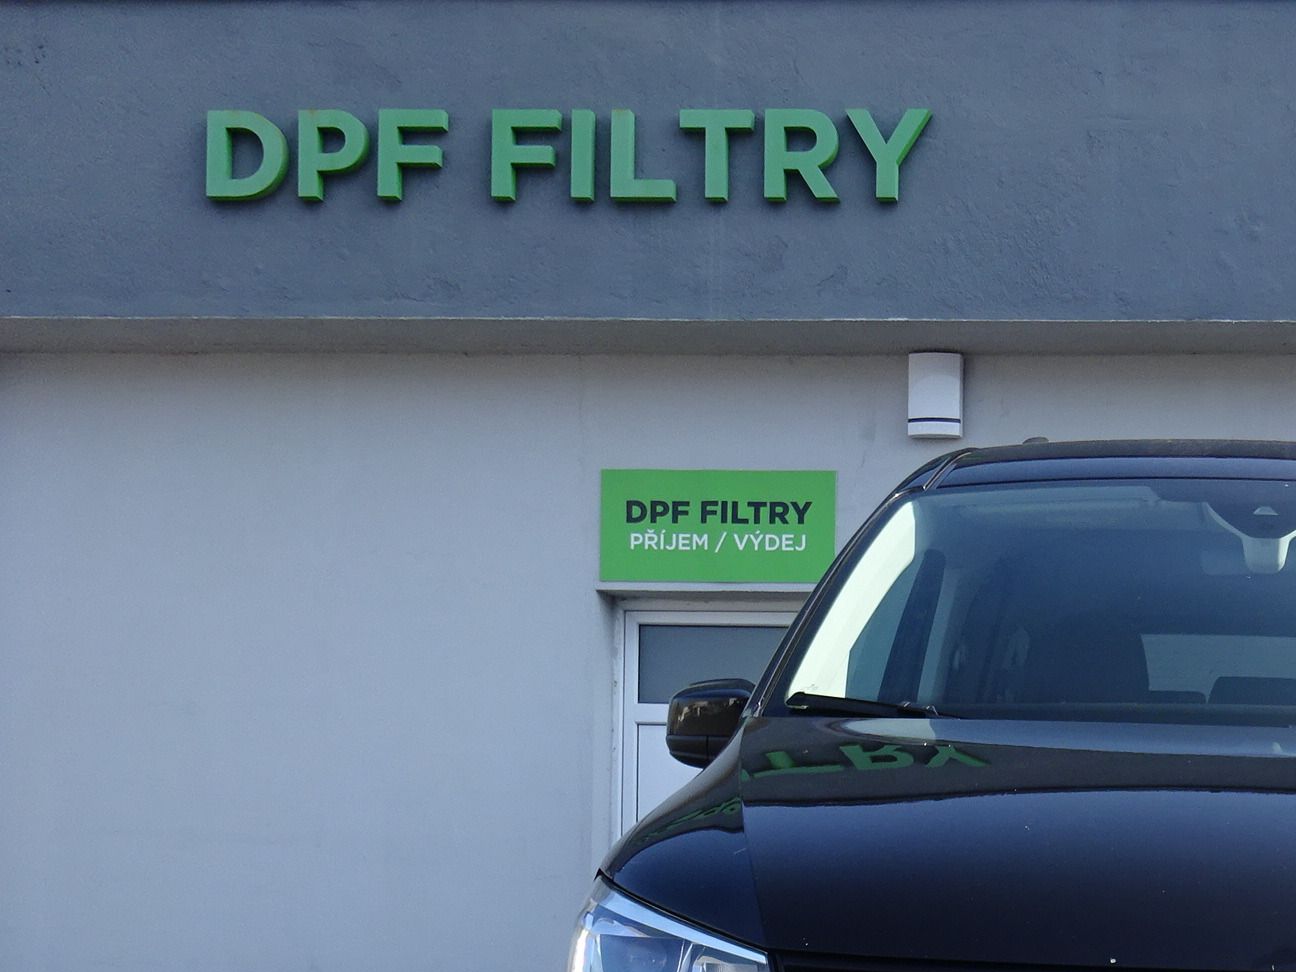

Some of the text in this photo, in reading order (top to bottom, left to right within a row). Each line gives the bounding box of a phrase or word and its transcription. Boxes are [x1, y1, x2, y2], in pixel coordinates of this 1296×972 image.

[205, 108, 934, 202] DPF FILTRY
[625, 499, 813, 525] DPF FILTRY
[629, 529, 709, 551] PŘÍJEM
[733, 530, 807, 552] VÝDEJ
